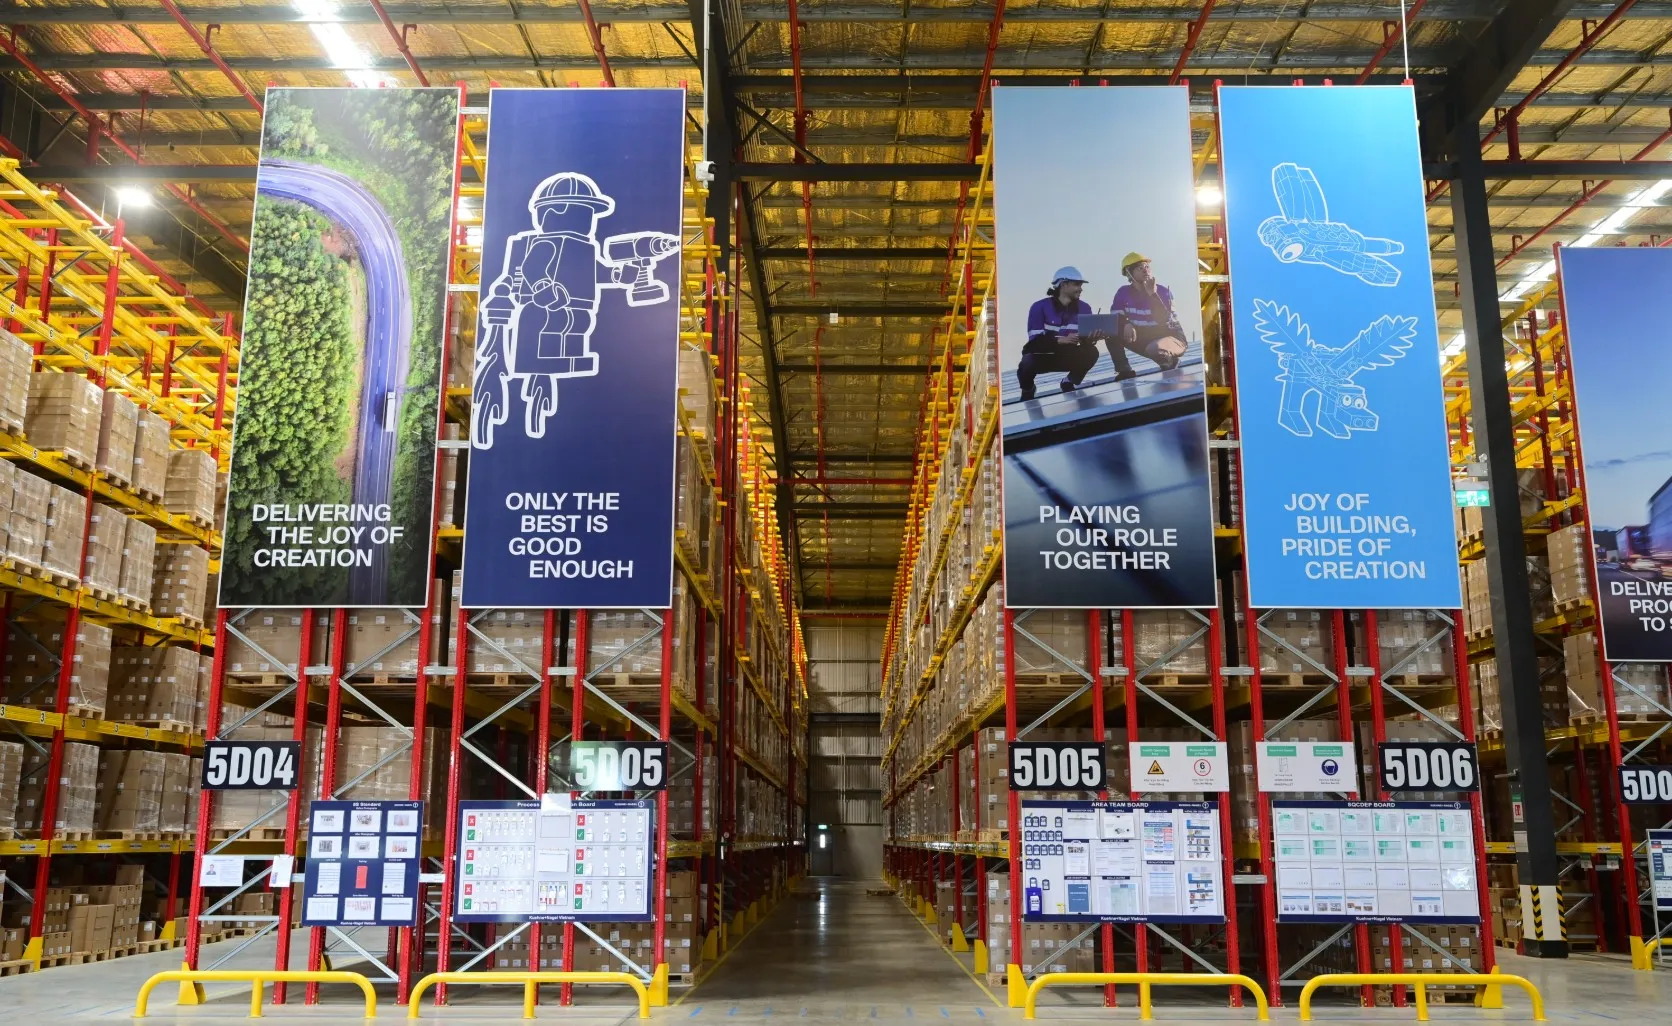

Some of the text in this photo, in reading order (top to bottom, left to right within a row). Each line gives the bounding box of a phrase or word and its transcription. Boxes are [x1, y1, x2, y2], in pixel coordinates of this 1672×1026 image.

[506, 492, 620, 511] ONLY THE
[1285, 493, 1369, 511] JOY OF
[253, 503, 392, 522] DELIVERING
[1039, 505, 1140, 524] PLAYING
[521, 514, 608, 533] BEST IS
[1297, 515, 1417, 537] BUILDING,
[267, 525, 404, 545] THE JOY OF
[1056, 528, 1178, 547] OUR ROLE
[508, 537, 582, 556] GOOD
[1282, 538, 1391, 556] PRIDE OF
[253, 548, 373, 567] CREATION
[1039, 550, 1171, 570] TOGETHER
[529, 559, 634, 579] ENOUGH
[1305, 560, 1426, 579] CREATION
[1629, 598, 1672, 614] PRO
[1638, 616, 1666, 632] TO
[206, 746, 294, 786] 5D04
[575, 747, 663, 787] 5D05
[1013, 747, 1101, 787] 5D05
[1199, 762, 1205, 770] 6
[1384, 748, 1474, 788] 5D06
